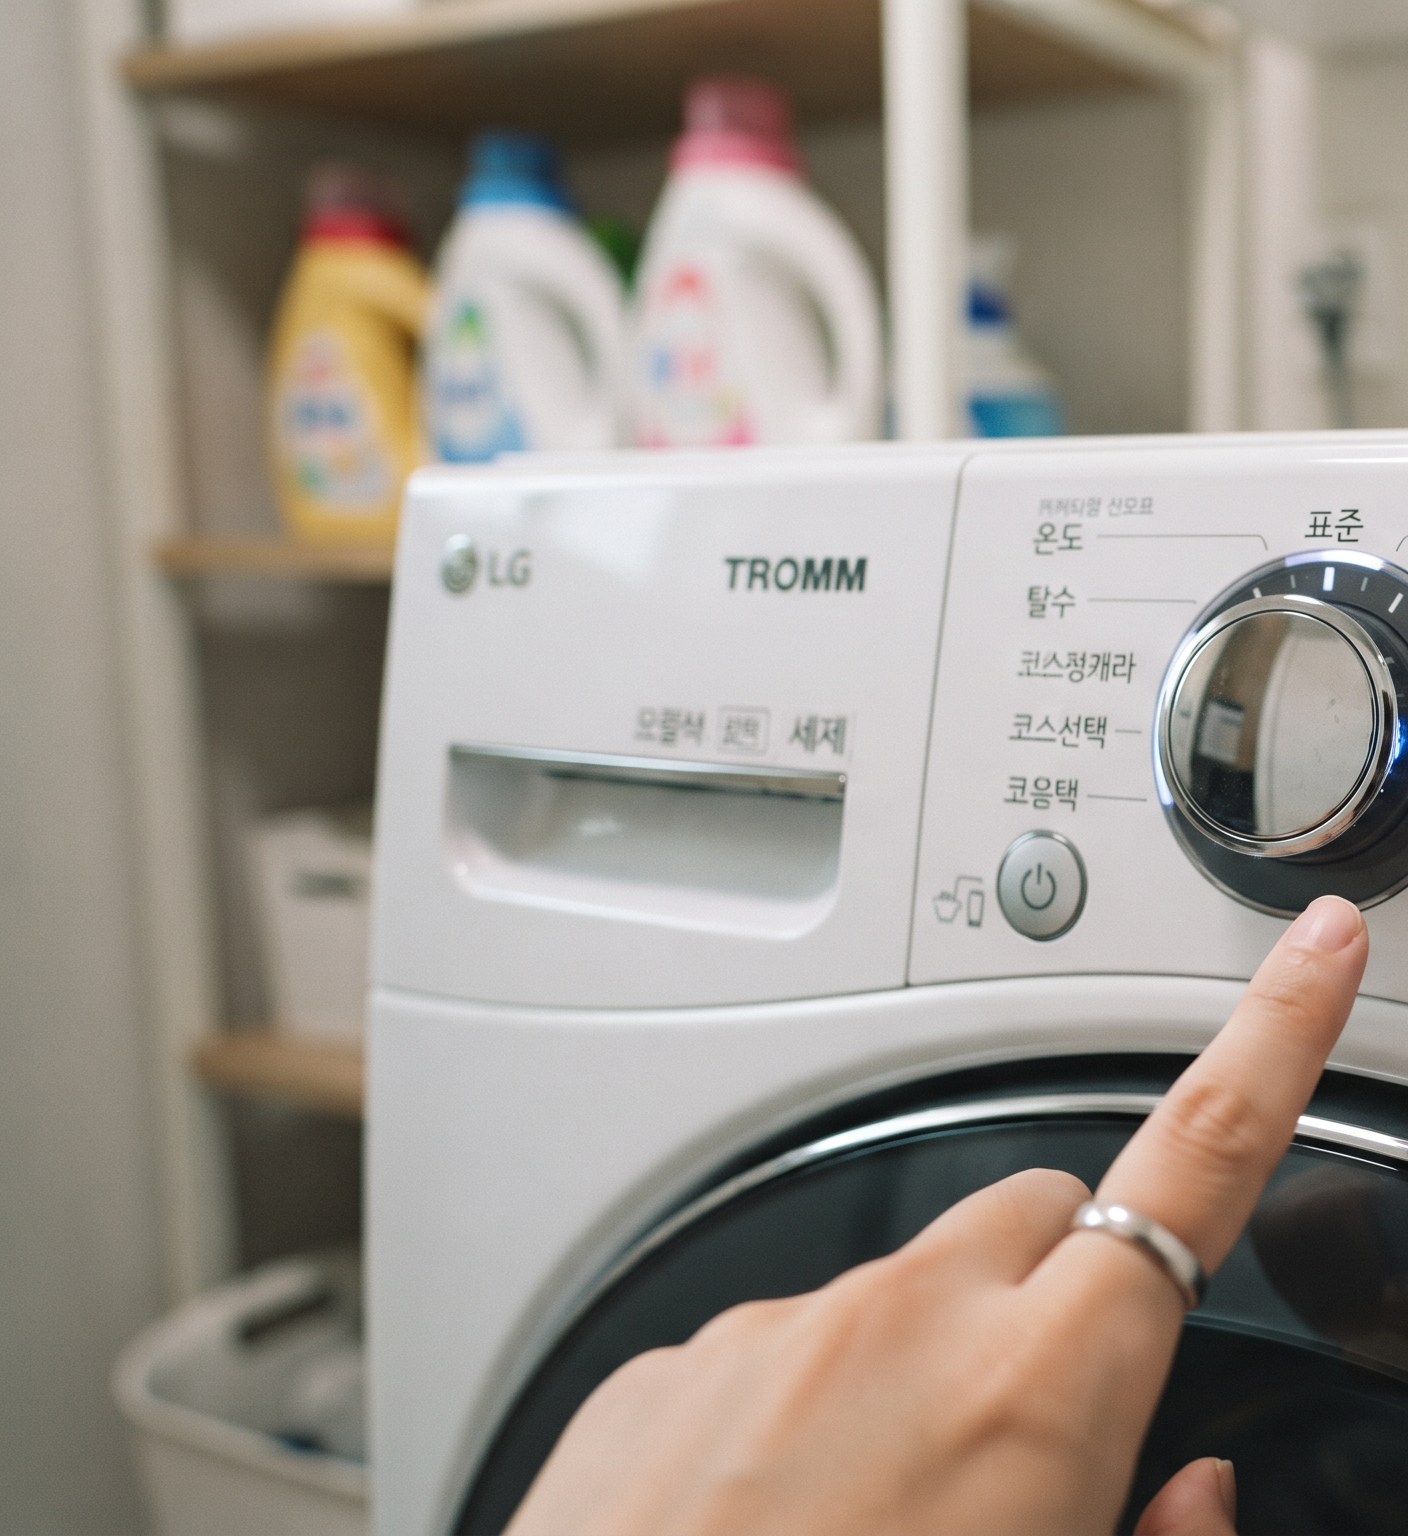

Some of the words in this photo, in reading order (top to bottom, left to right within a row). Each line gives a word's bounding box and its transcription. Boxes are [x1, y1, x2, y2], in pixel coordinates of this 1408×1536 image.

[1033, 521, 1083, 556] 온도
[1304, 508, 1364, 544] 표준
[487, 549, 532, 589] LG
[725, 557, 868, 592] TROMM
[1026, 585, 1076, 620] 탈수
[789, 715, 847, 755] 세제
[1009, 713, 1108, 750] 코스선택
[1003, 776, 1079, 812] 코음택
